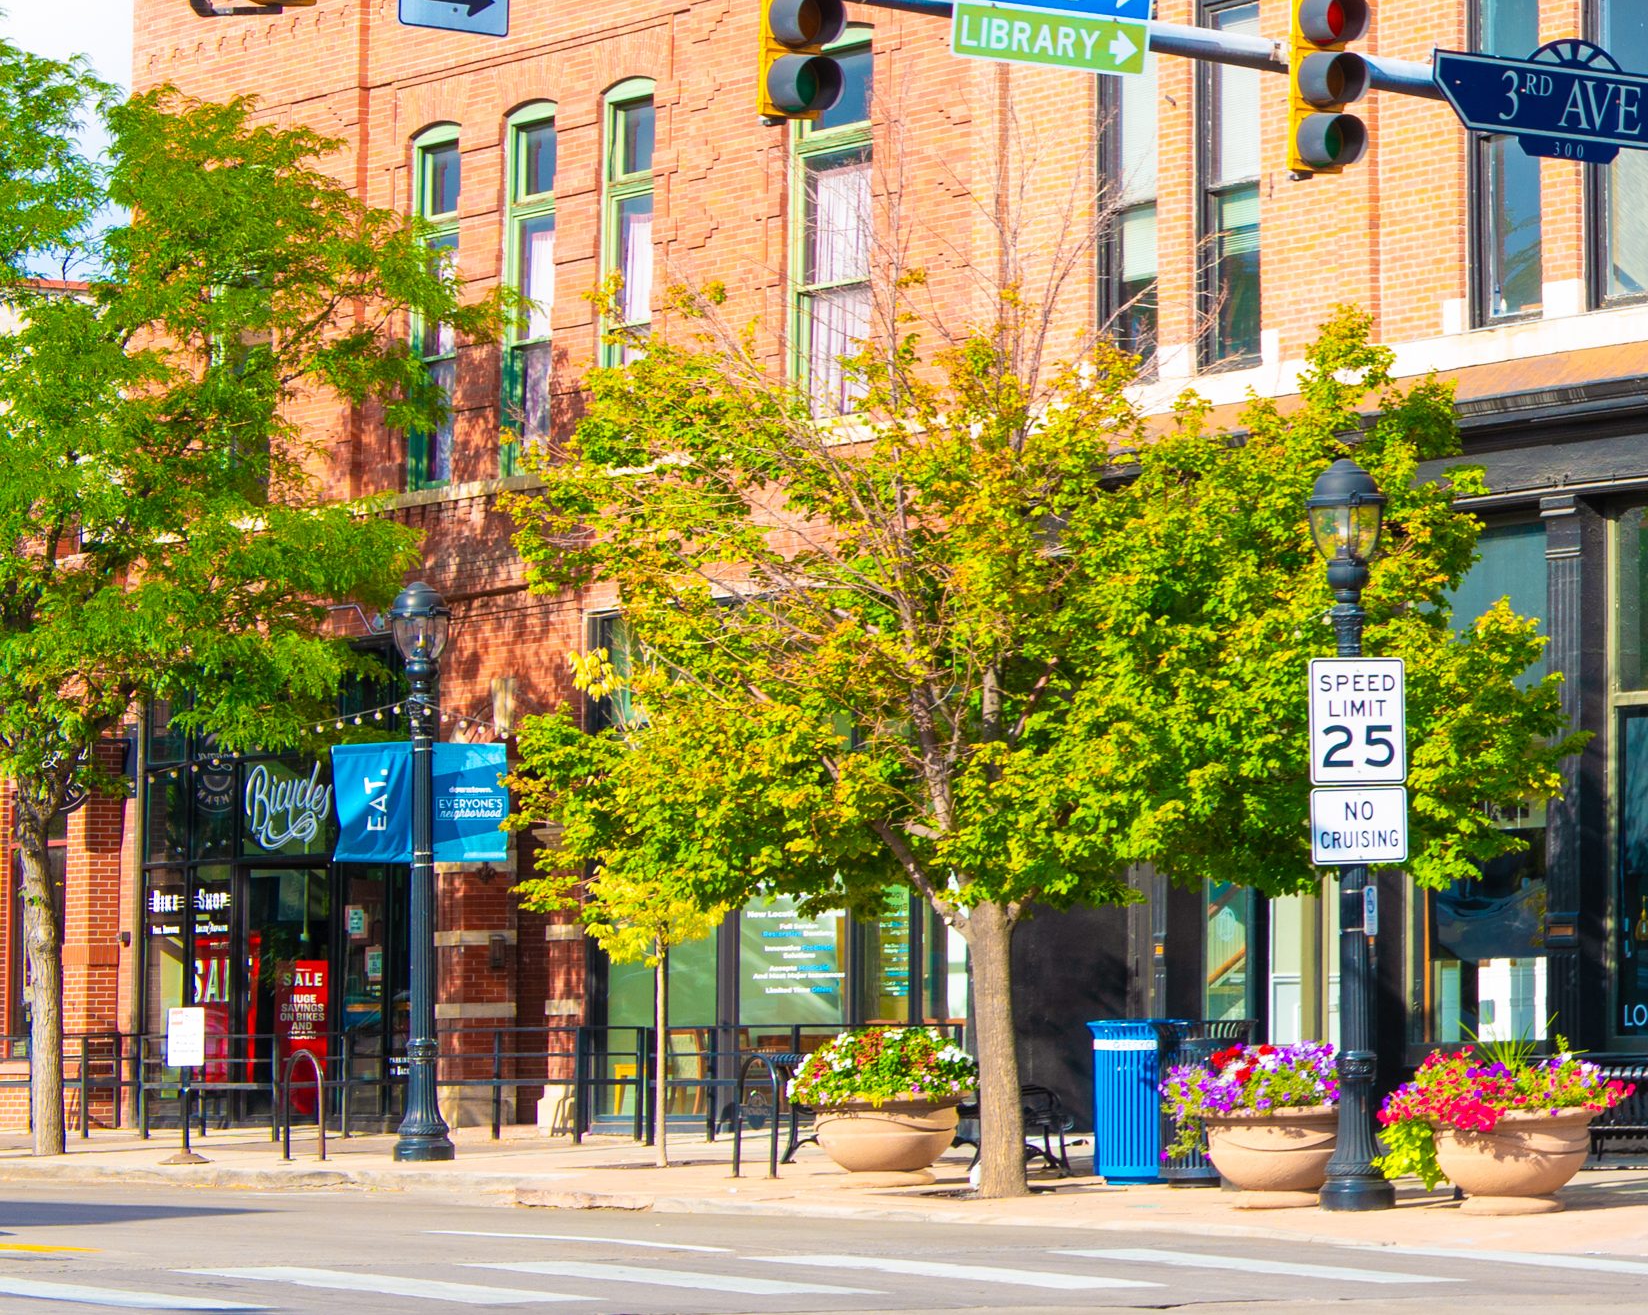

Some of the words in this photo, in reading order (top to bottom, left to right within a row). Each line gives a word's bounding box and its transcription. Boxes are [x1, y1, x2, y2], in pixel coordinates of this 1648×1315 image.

[960, 14, 1100, 60] LIBRARY
[1498, 70, 1553, 122] 3RD
[1560, 79, 1642, 135] AVE
[1554, 141, 1585, 159] 300
[1320, 672, 1396, 694] SPEED
[1329, 699, 1387, 718] LIMIT
[1322, 724, 1396, 768] 25
[245, 760, 333, 851] Bicycles
[439, 798, 503, 809] EVERYONE'S
[1344, 801, 1374, 822] NO
[440, 808, 502, 820] neighborhood
[1320, 829, 1399, 850] CRUISING
[768, 910, 798, 918] Locatio
[283, 973, 323, 987] SALE
[290, 994, 316, 1003] HUGE
[280, 1012, 293, 1021] ON
[296, 1012, 325, 1021] BIKES
[281, 1003, 324, 1013] SAVINGS
[292, 1022, 312, 1031] AND
